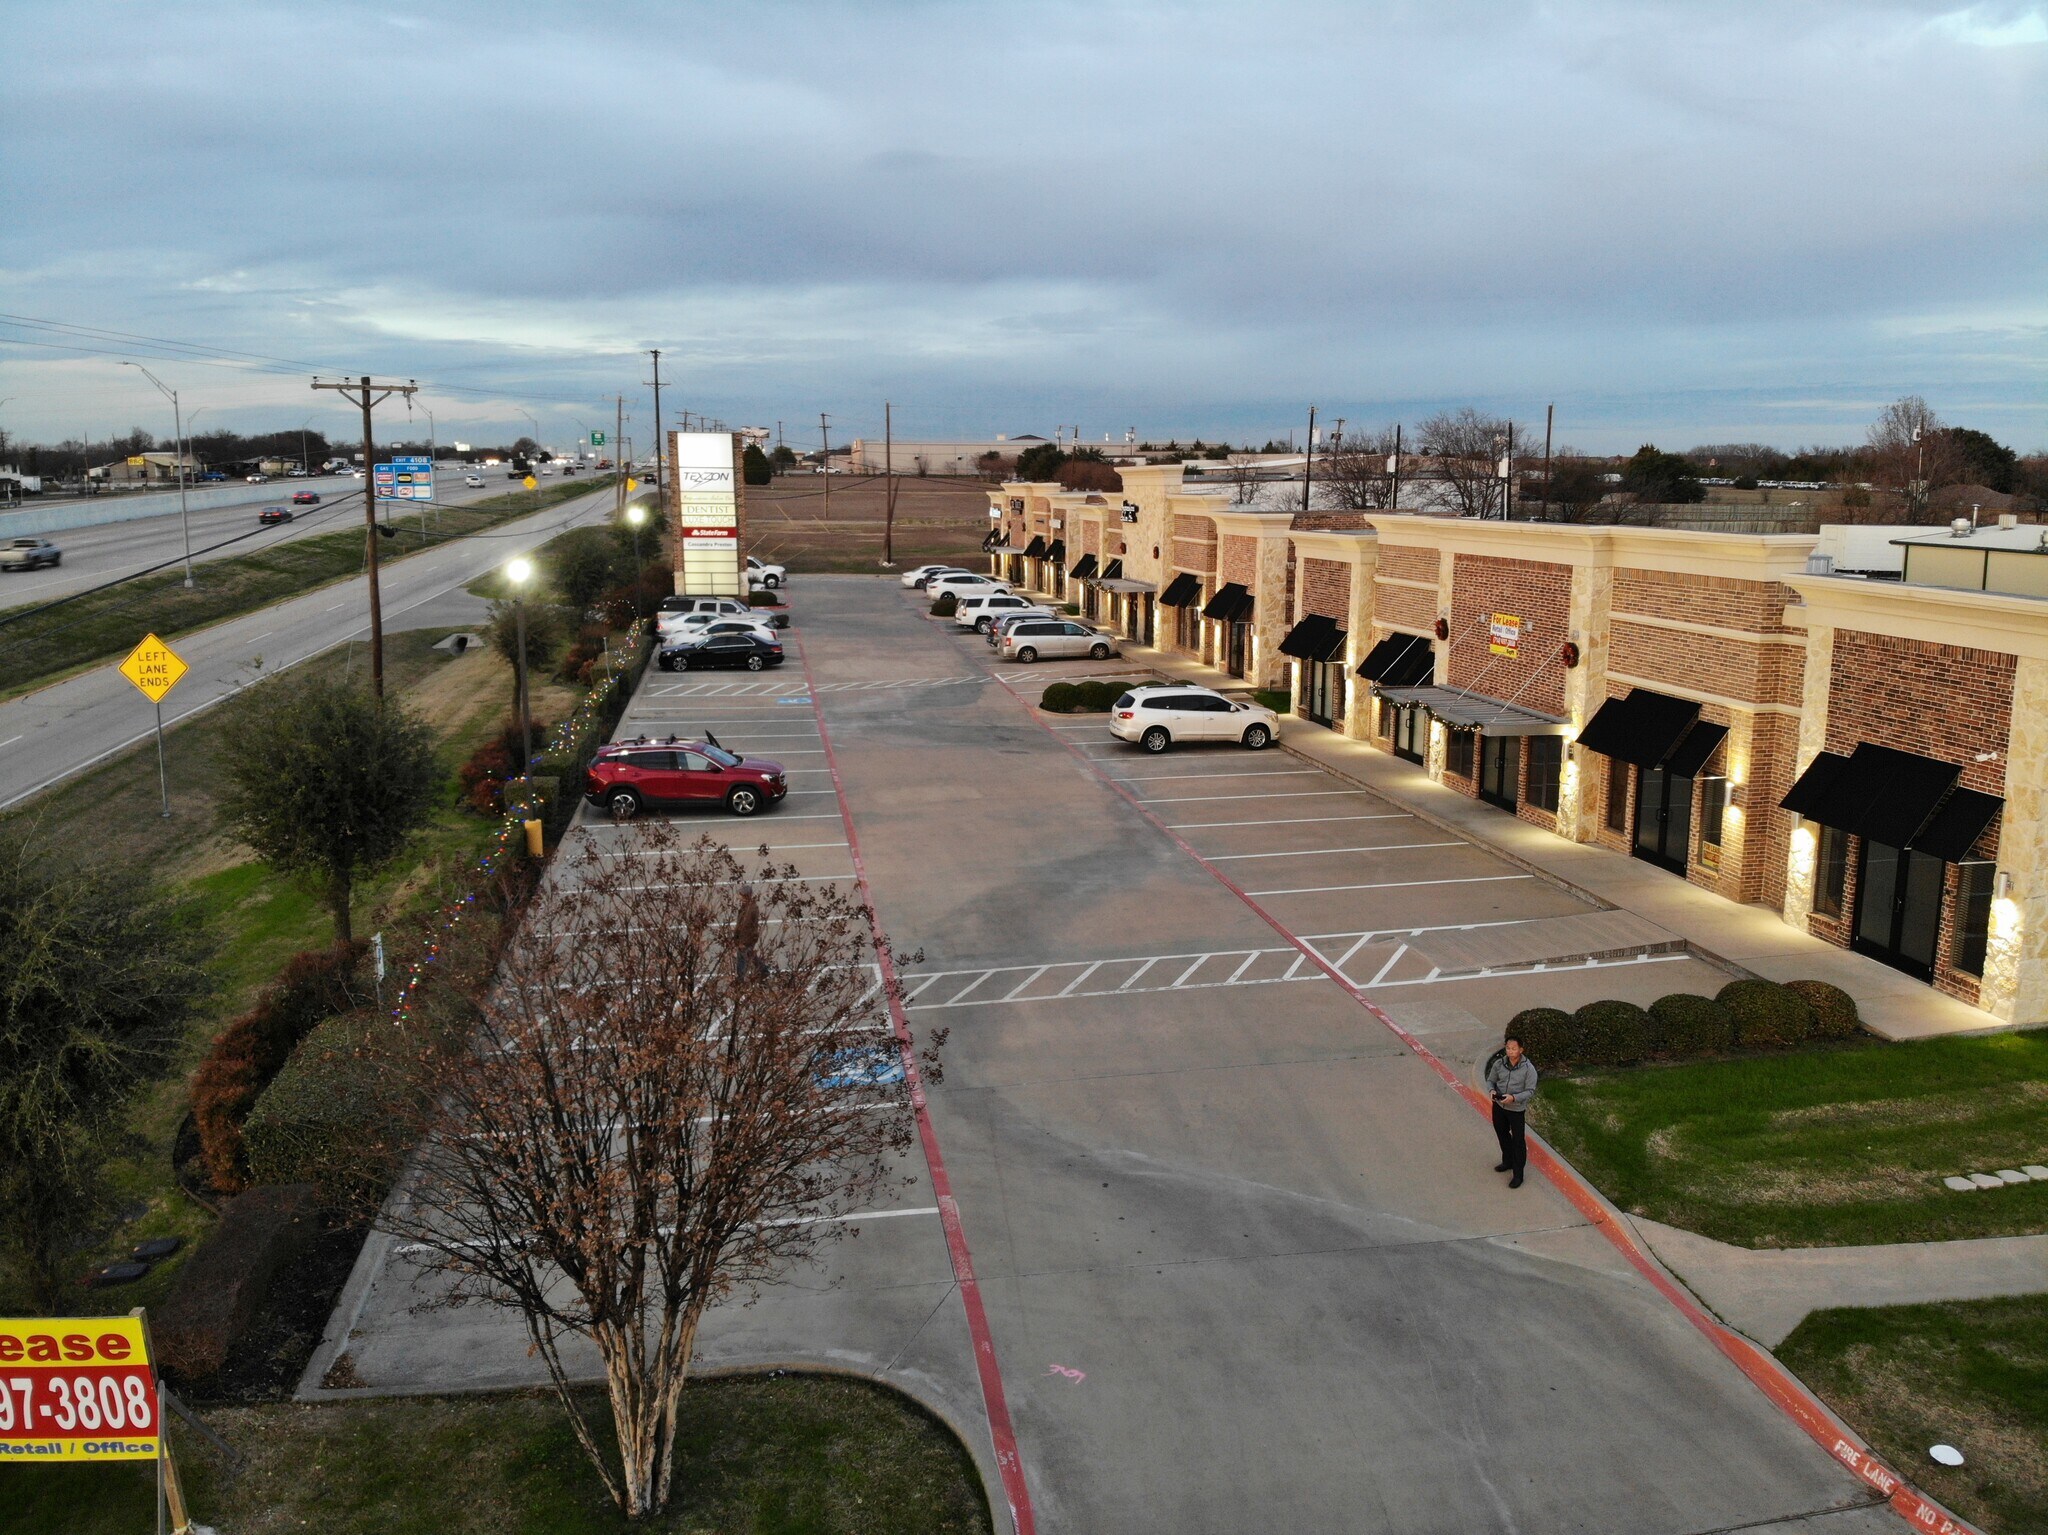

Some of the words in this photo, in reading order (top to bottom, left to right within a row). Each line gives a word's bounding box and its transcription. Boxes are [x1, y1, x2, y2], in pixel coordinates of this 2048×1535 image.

[687, 505, 730, 513] DENTIST
[706, 515, 734, 523] TOUCH
[1493, 614, 1501, 624] For
[1503, 616, 1518, 628] Lease
[138, 652, 166, 661] LEFT
[139, 665, 168, 674] LANE
[140, 677, 170, 687] ENDS
[0, 1333, 131, 1361] ease
[0, 1443, 62, 1454] Retail
[83, 1441, 155, 1454] Office
[1834, 1439, 1861, 1467] FIRE
[1863, 1461, 1895, 1495] LANE
[1916, 1503, 1936, 1525] NO
